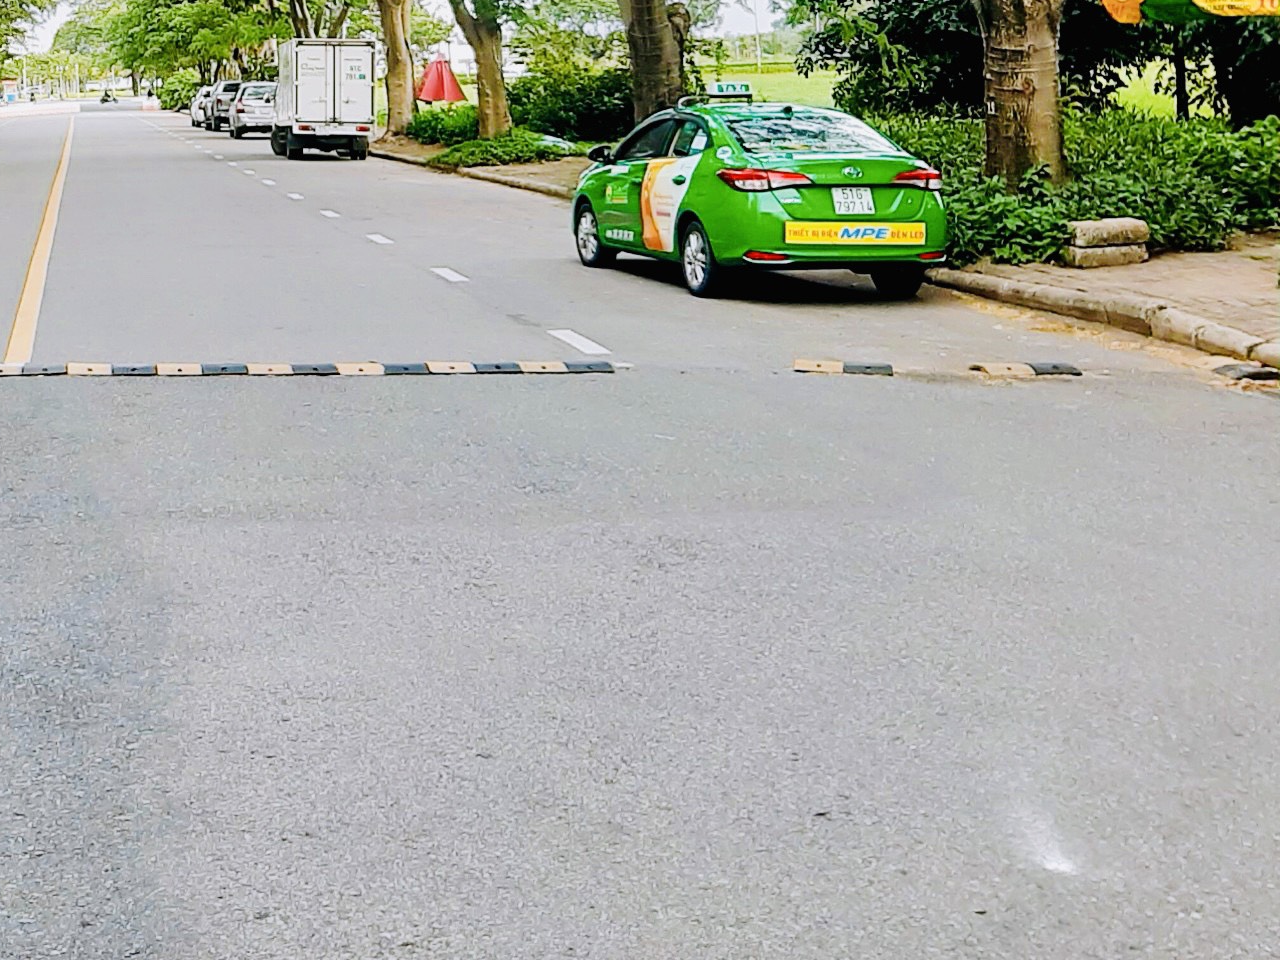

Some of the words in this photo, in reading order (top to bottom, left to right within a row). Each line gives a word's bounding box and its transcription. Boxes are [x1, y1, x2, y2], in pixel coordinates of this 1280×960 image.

[841, 188, 863, 200] 51G
[840, 227, 889, 239] MPE
[909, 230, 925, 239] LED
